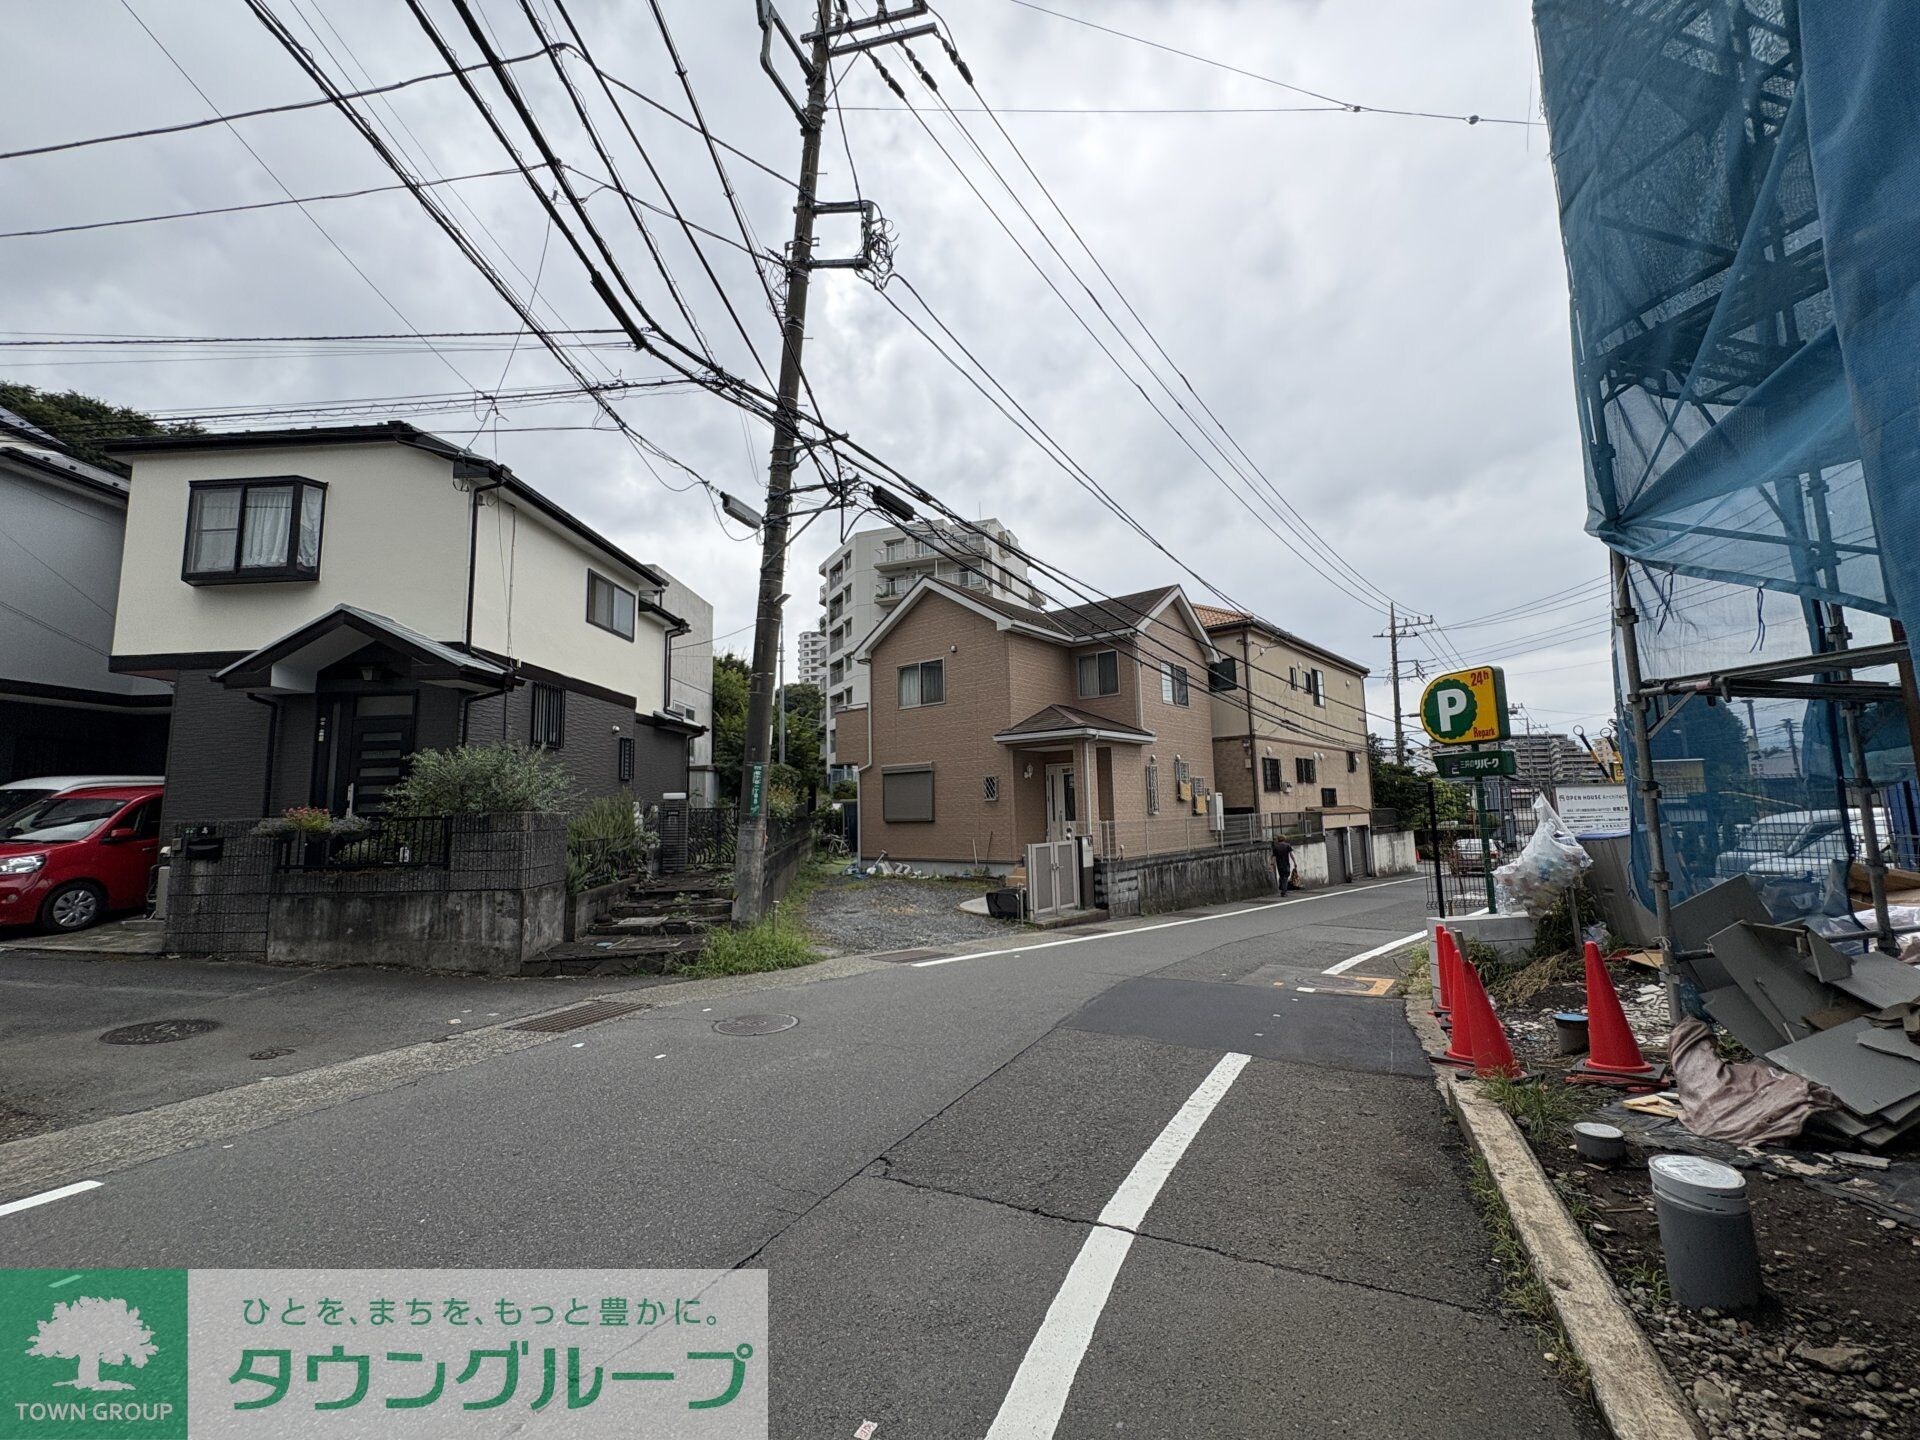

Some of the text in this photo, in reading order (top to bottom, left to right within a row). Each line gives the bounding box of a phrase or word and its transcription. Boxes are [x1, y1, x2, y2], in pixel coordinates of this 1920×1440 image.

[1470, 670, 1489, 687] 24h
[1437, 688, 1467, 732] P
[1473, 727, 1496, 739] Repark
